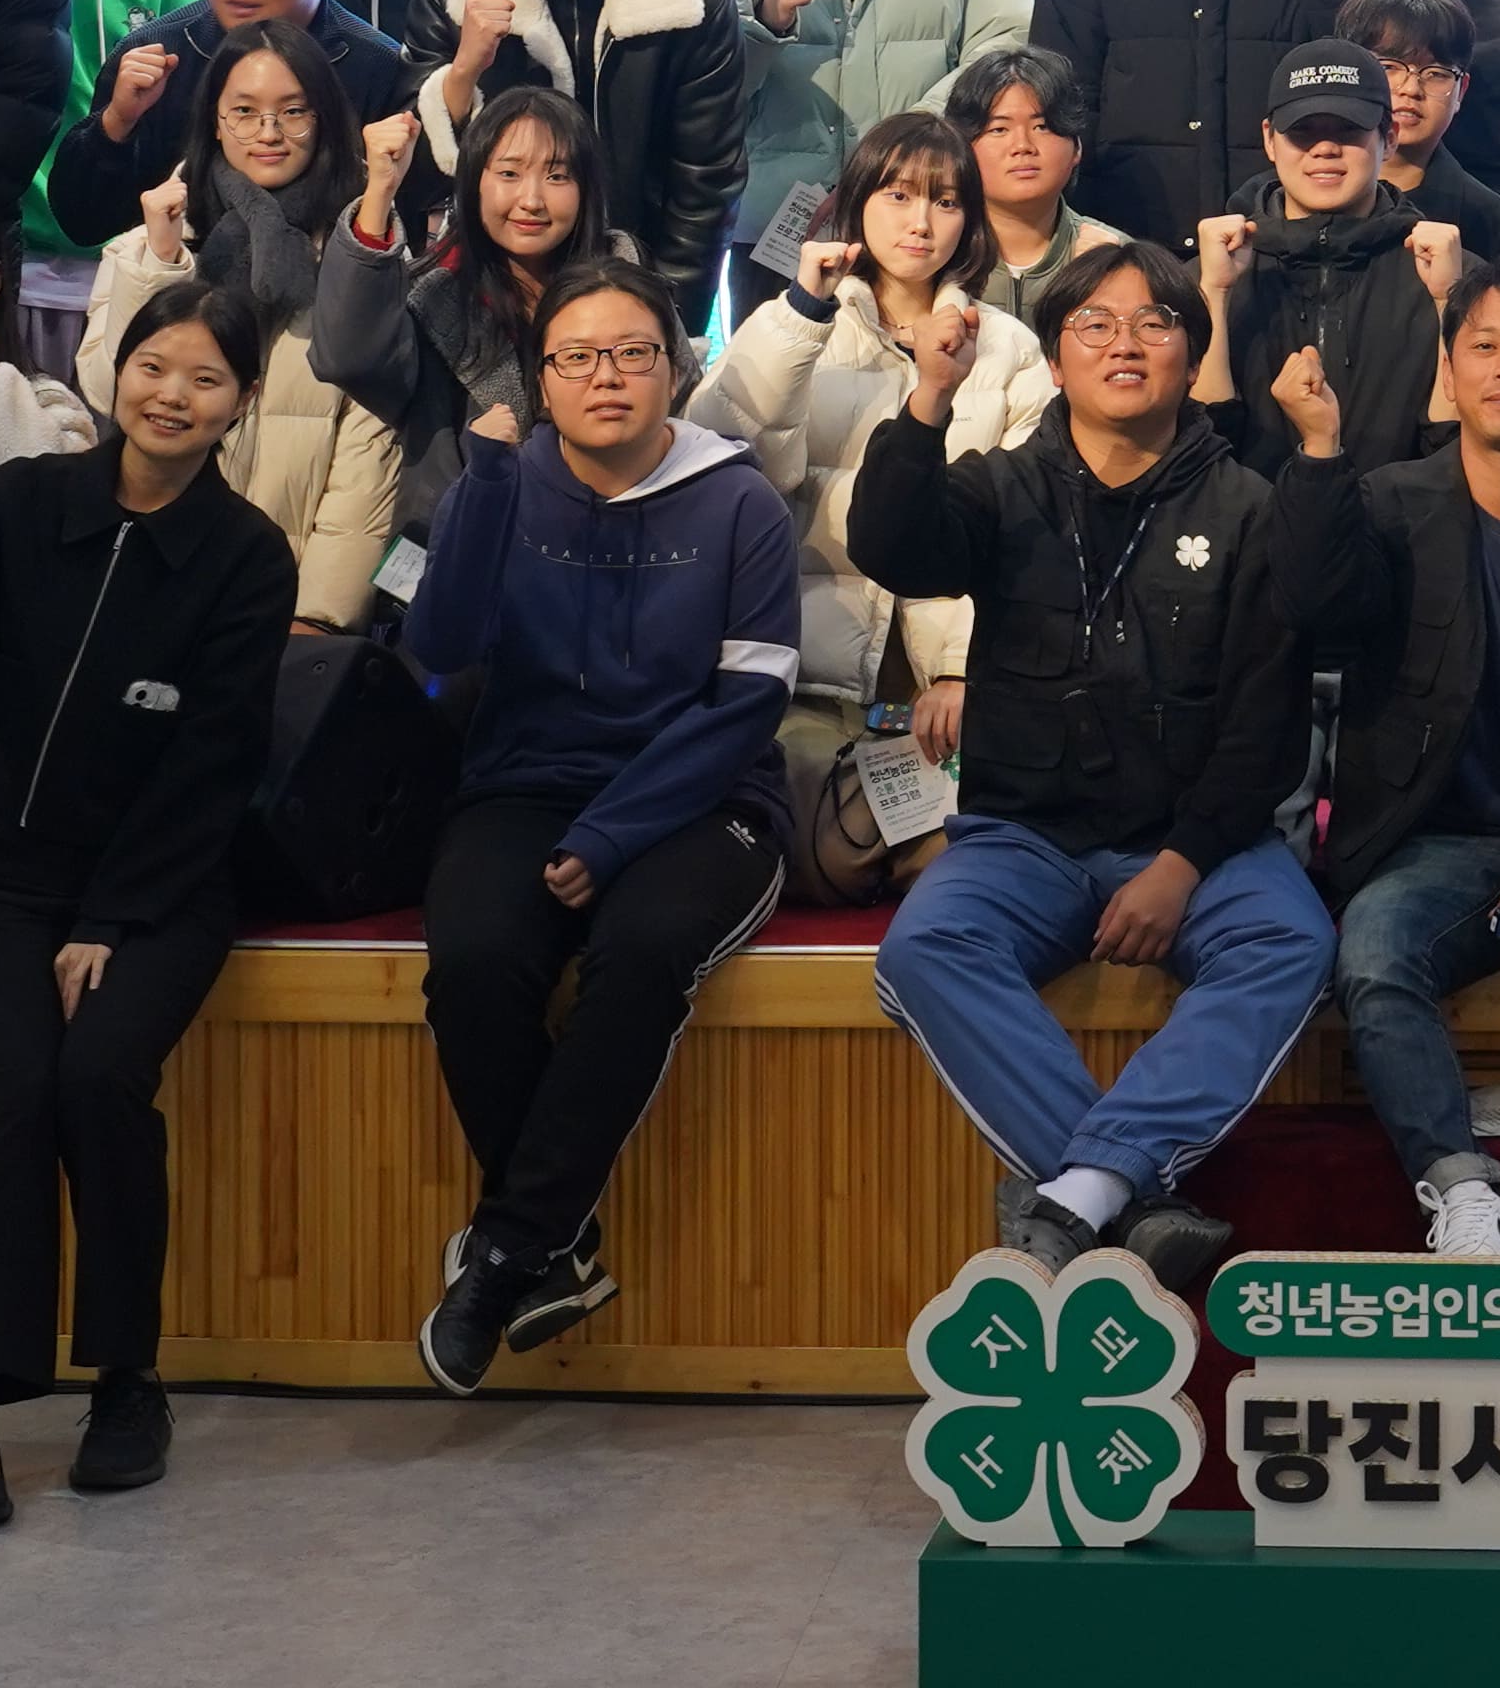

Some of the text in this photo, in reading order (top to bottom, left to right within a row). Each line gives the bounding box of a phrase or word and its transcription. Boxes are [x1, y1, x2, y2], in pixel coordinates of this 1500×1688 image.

[1289, 64, 1360, 81] MAKE COMEDY
[1289, 74, 1360, 89] GREAT AGAIN
[868, 758, 921, 784] 청년농업인
[879, 788, 923, 811] 프로그램
